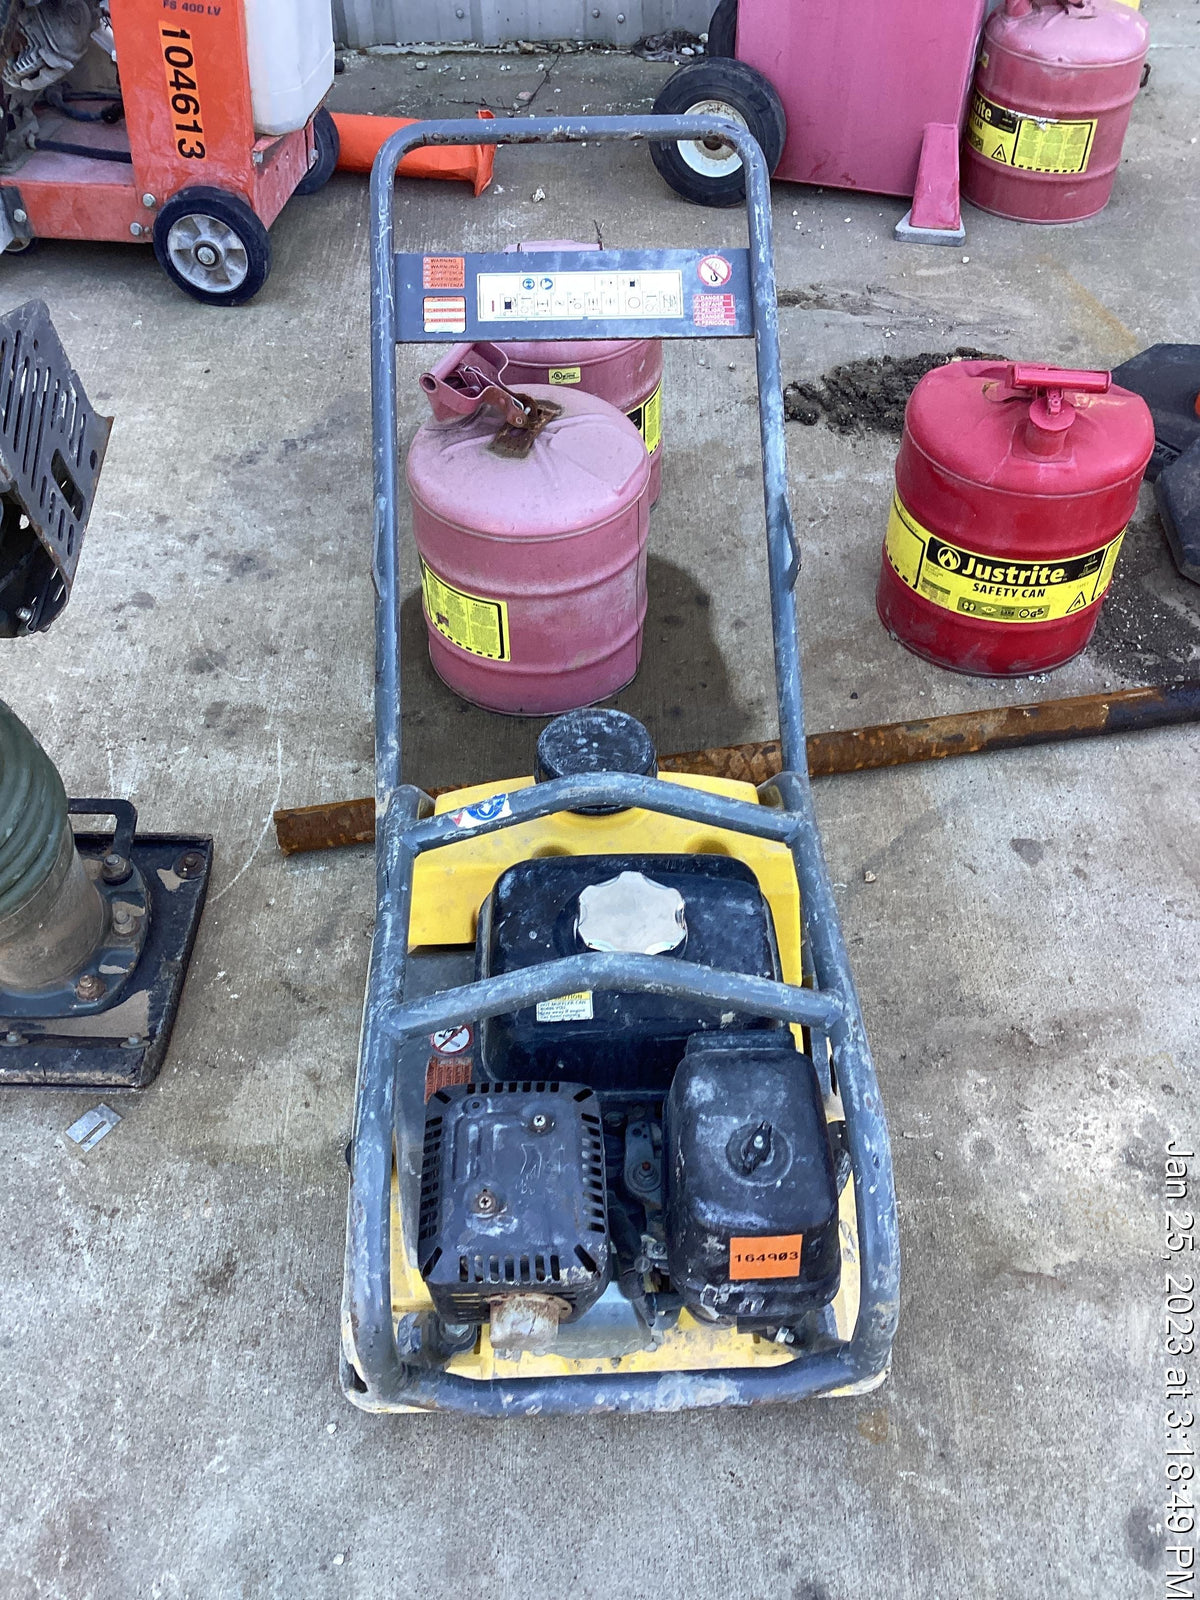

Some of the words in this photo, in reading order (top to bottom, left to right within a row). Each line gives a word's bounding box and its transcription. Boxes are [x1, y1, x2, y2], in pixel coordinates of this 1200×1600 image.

[182, 2, 204, 14] 400
[207, 5, 221, 16] LV
[161, 28, 206, 160] 104613
[961, 557, 1065, 585] Justrite
[972, 582, 1018, 598] SAFETY
[1021, 587, 1046, 598] CAN
[734, 1251, 799, 1263] 164903
